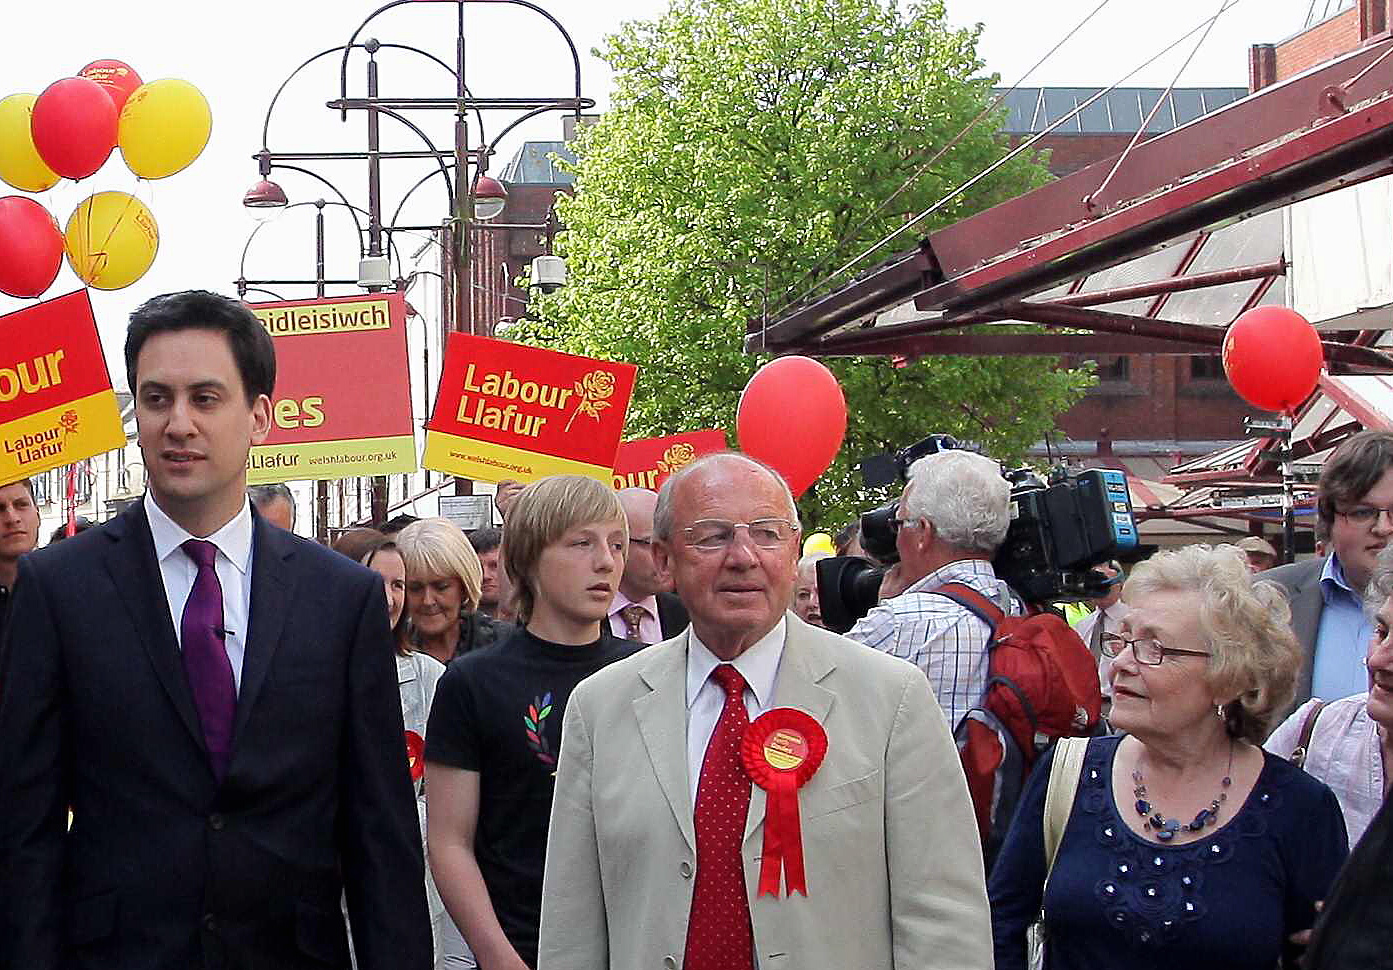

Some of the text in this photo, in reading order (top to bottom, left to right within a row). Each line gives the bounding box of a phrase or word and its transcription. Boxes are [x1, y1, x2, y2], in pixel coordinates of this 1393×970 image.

[464, 363, 574, 410] Labour
[456, 395, 547, 438] Llafur
[4, 427, 61, 454] Labour
[17, 442, 63, 465] Llafur
